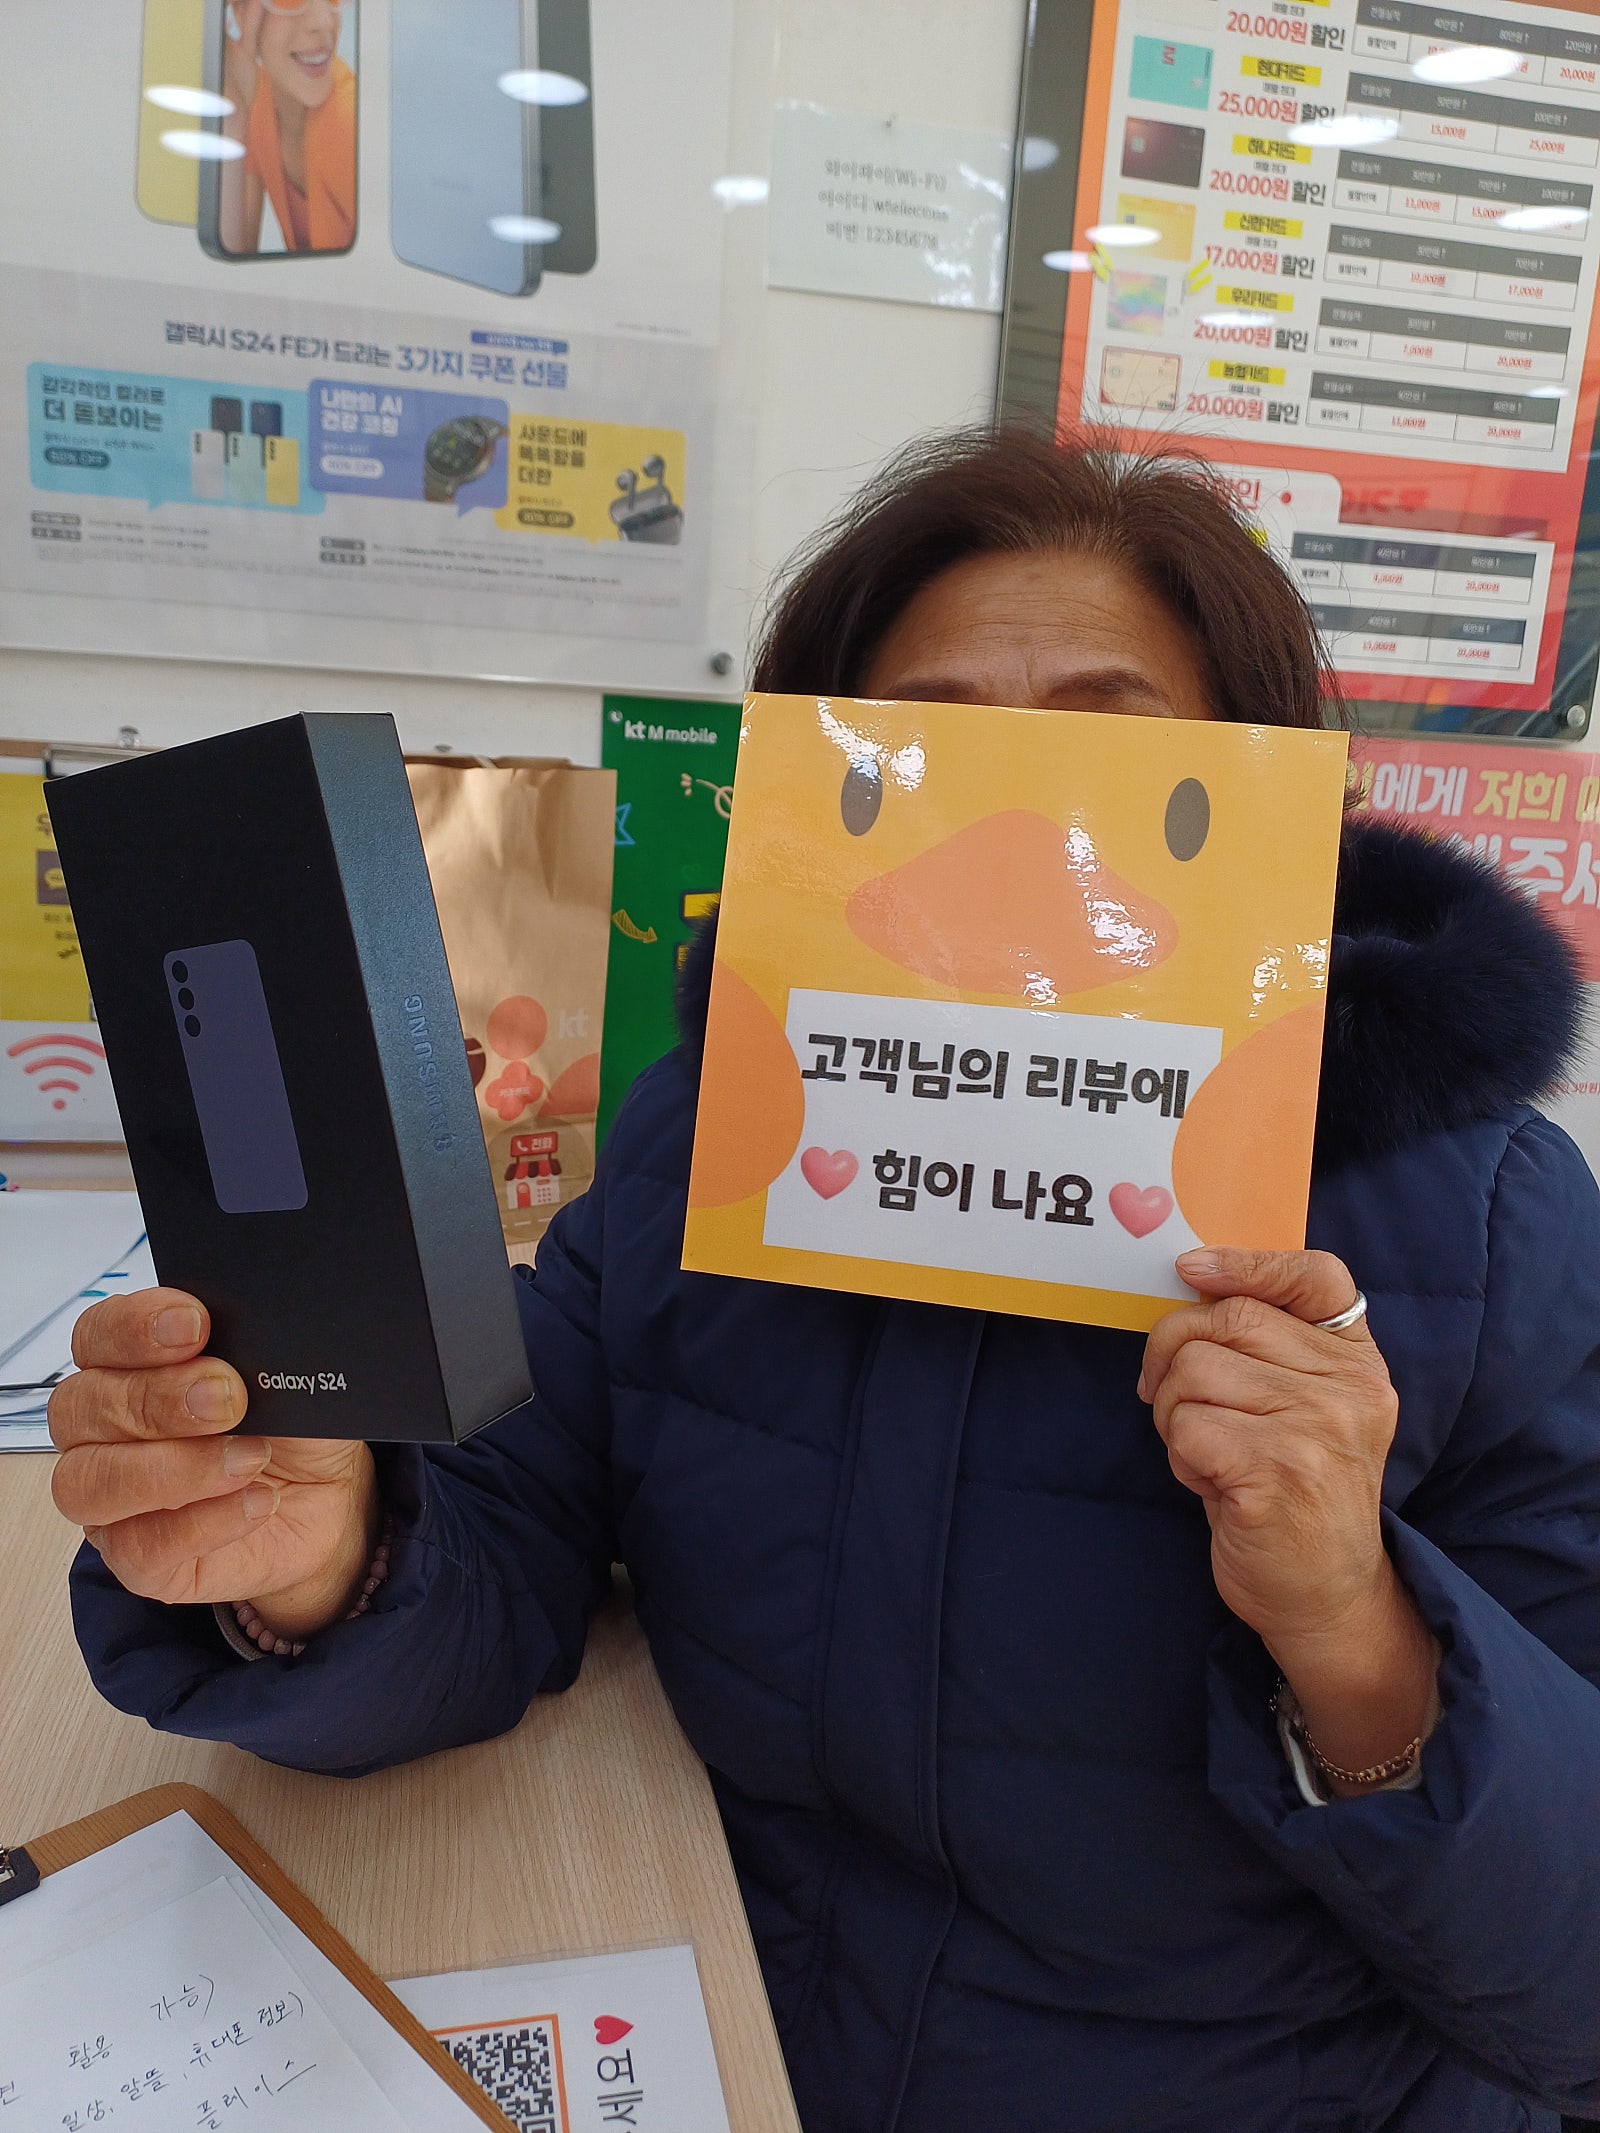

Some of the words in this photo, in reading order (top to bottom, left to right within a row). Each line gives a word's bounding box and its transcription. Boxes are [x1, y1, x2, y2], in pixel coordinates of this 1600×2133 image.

[1226, 10, 1308, 45] 20,000원
[1311, 24, 1345, 51] 할인
[1559, 66, 1596, 83] 20,000원
[1218, 92, 1298, 124] 25,000원
[1209, 169, 1289, 201] 20,000원
[1292, 180, 1326, 206] 할인
[1204, 244, 1278, 275] 17,000원
[1281, 253, 1315, 279] 할인
[165, 320, 225, 348] 갤럭시
[230, 328, 275, 353] S24
[397, 345, 464, 377] 3가지
[469, 353, 514, 384] 쿠폰
[522, 358, 568, 388] 선물
[1193, 319, 1272, 349] 20,000원
[1275, 327, 1308, 352] 할인
[44, 399, 66, 420] 더
[1186, 392, 1264, 422] 20,000원
[1267, 401, 1300, 425] 할인
[625, 721, 646, 739] kt
[648, 726, 663, 740] M
[666, 728, 718, 744] mobile
[1473, 770, 1567, 822] 저희
[558, 1008, 589, 1040] kt
[404, 994, 453, 1152] SAMSUNG
[801, 1032, 1009, 1100] 고객님의
[1027, 1054, 1190, 1119] 리뷰에
[873, 1149, 975, 1213] 힘이
[992, 1170, 1095, 1227] 나요
[258, 1372, 316, 1394] Galaxy
[318, 1372, 347, 1391] S24
[68, 2034, 113, 2070] 활용
[150, 1973, 214, 2021] 가능)
[189, 2021, 253, 2068] 휴대폰
[257, 1991, 305, 2027] 정보)
[196, 2059, 317, 2130] 플레이스
[597, 2047, 643, 2128] 세요
